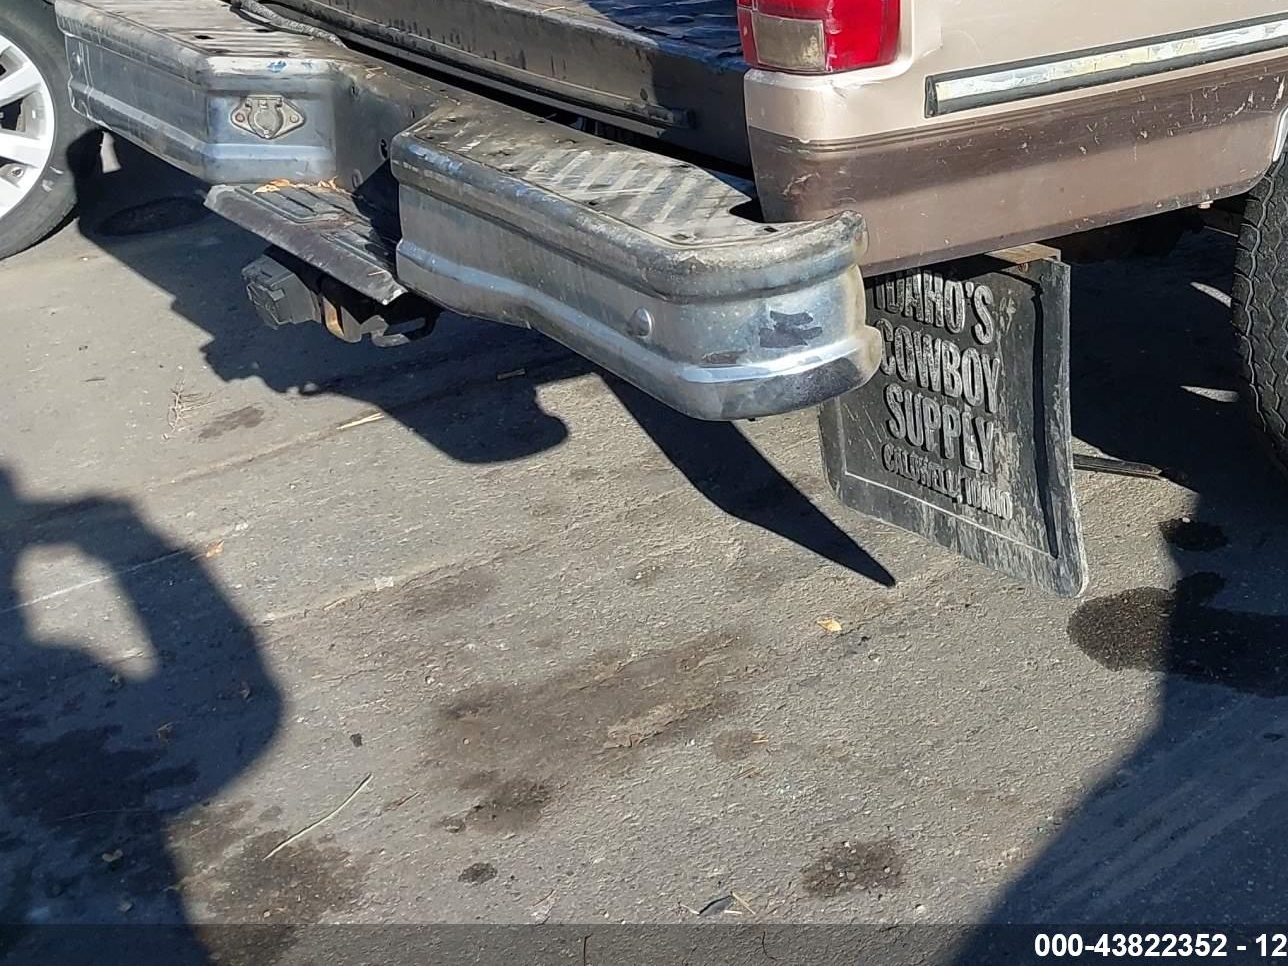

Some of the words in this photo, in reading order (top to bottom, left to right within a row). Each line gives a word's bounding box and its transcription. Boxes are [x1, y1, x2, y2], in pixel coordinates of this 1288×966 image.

[874, 268, 995, 346] IDAHO'S
[874, 318, 1001, 414] COWBOY
[884, 382, 995, 475] SUPPLY
[962, 476, 1013, 520] IDAHO
